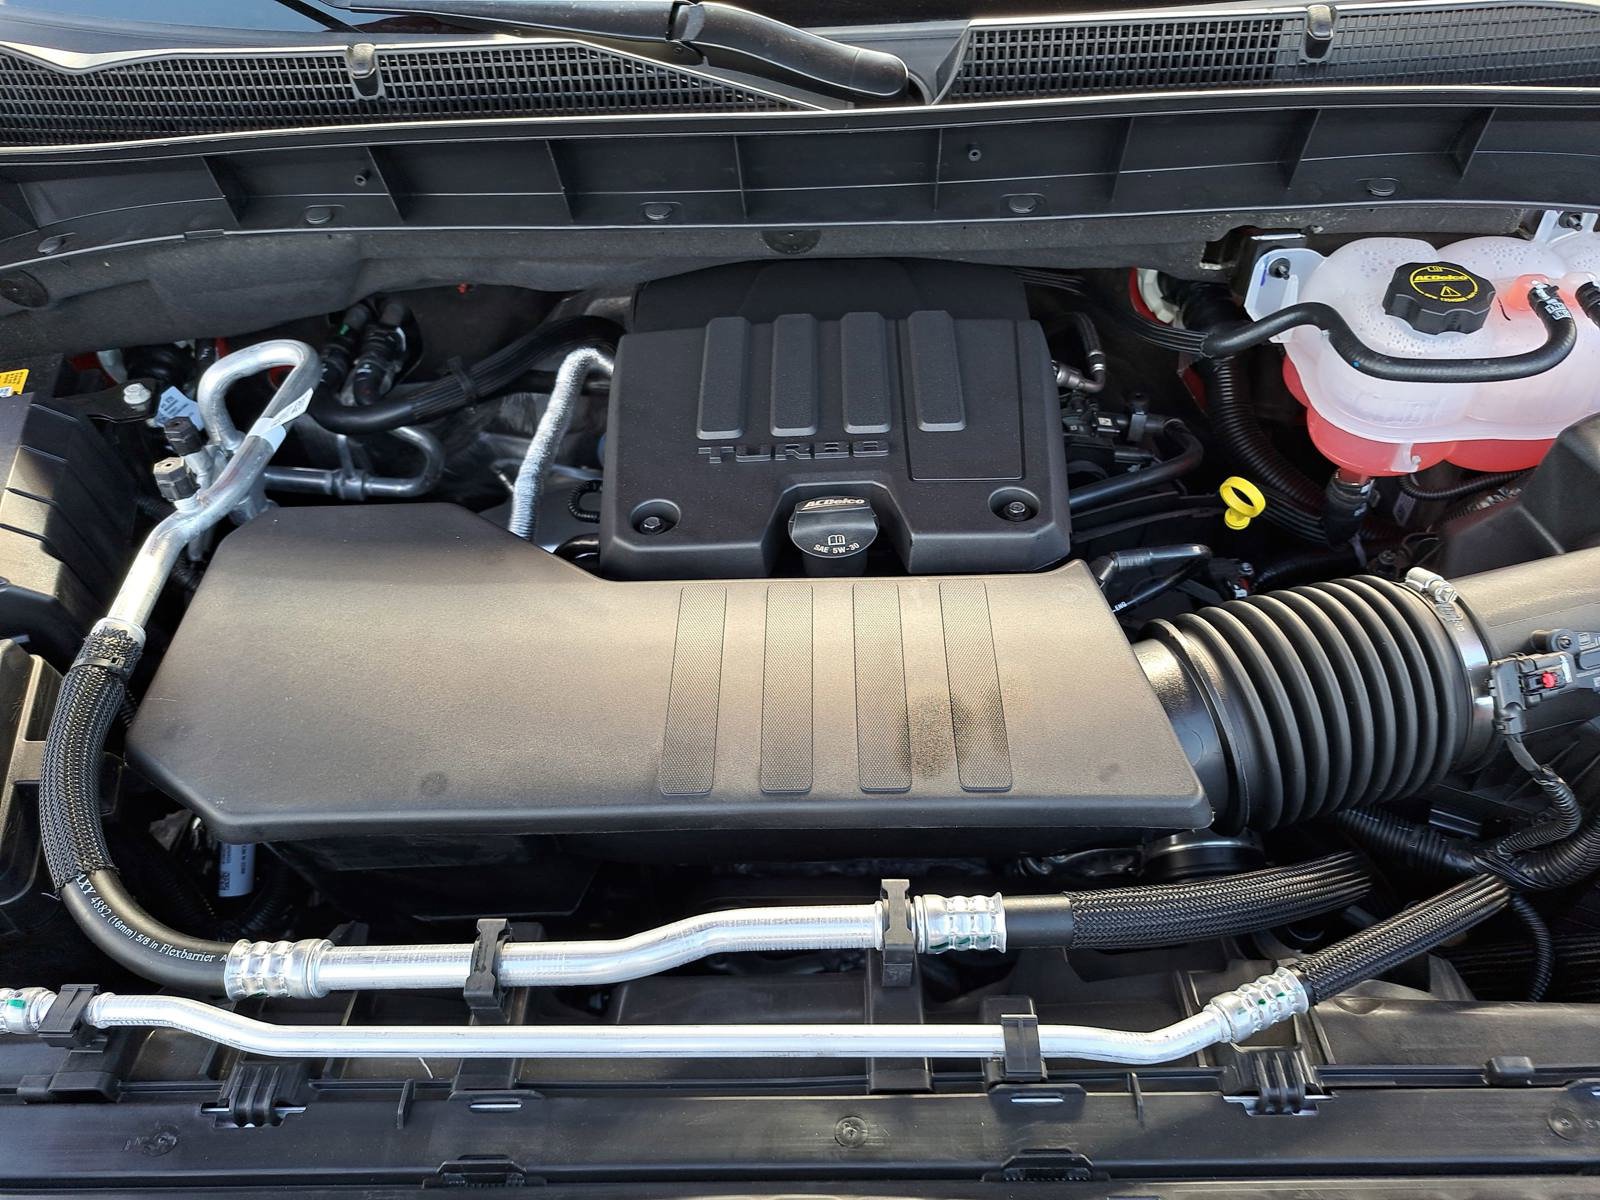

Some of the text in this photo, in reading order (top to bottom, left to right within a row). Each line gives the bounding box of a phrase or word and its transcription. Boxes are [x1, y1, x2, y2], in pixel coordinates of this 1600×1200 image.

[698, 440, 889, 464] TURBO
[804, 497, 866, 508] ACDelco
[813, 541, 860, 554] SAE 5W-30
[90, 896, 112, 919] 4882
[107, 915, 137, 940] (16mm)
[135, 934, 151, 946] 5/8
[159, 943, 216, 963] Flexbarrier
